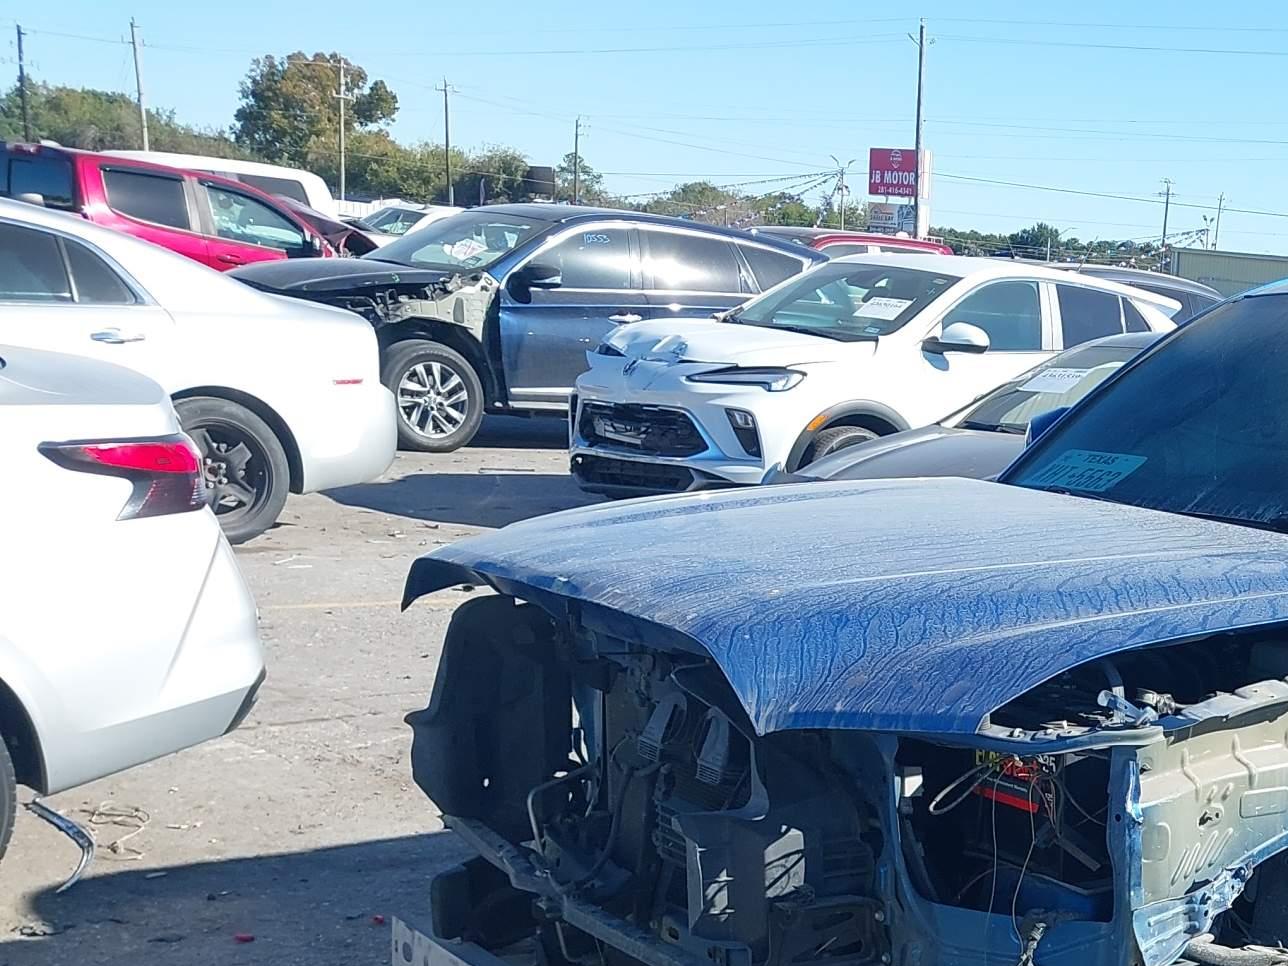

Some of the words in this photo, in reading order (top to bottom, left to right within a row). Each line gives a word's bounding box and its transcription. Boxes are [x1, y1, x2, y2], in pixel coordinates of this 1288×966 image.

[871, 170, 881, 184] JB
[884, 171, 916, 185] MOTOR
[1084, 454, 1119, 465] TEXAS
